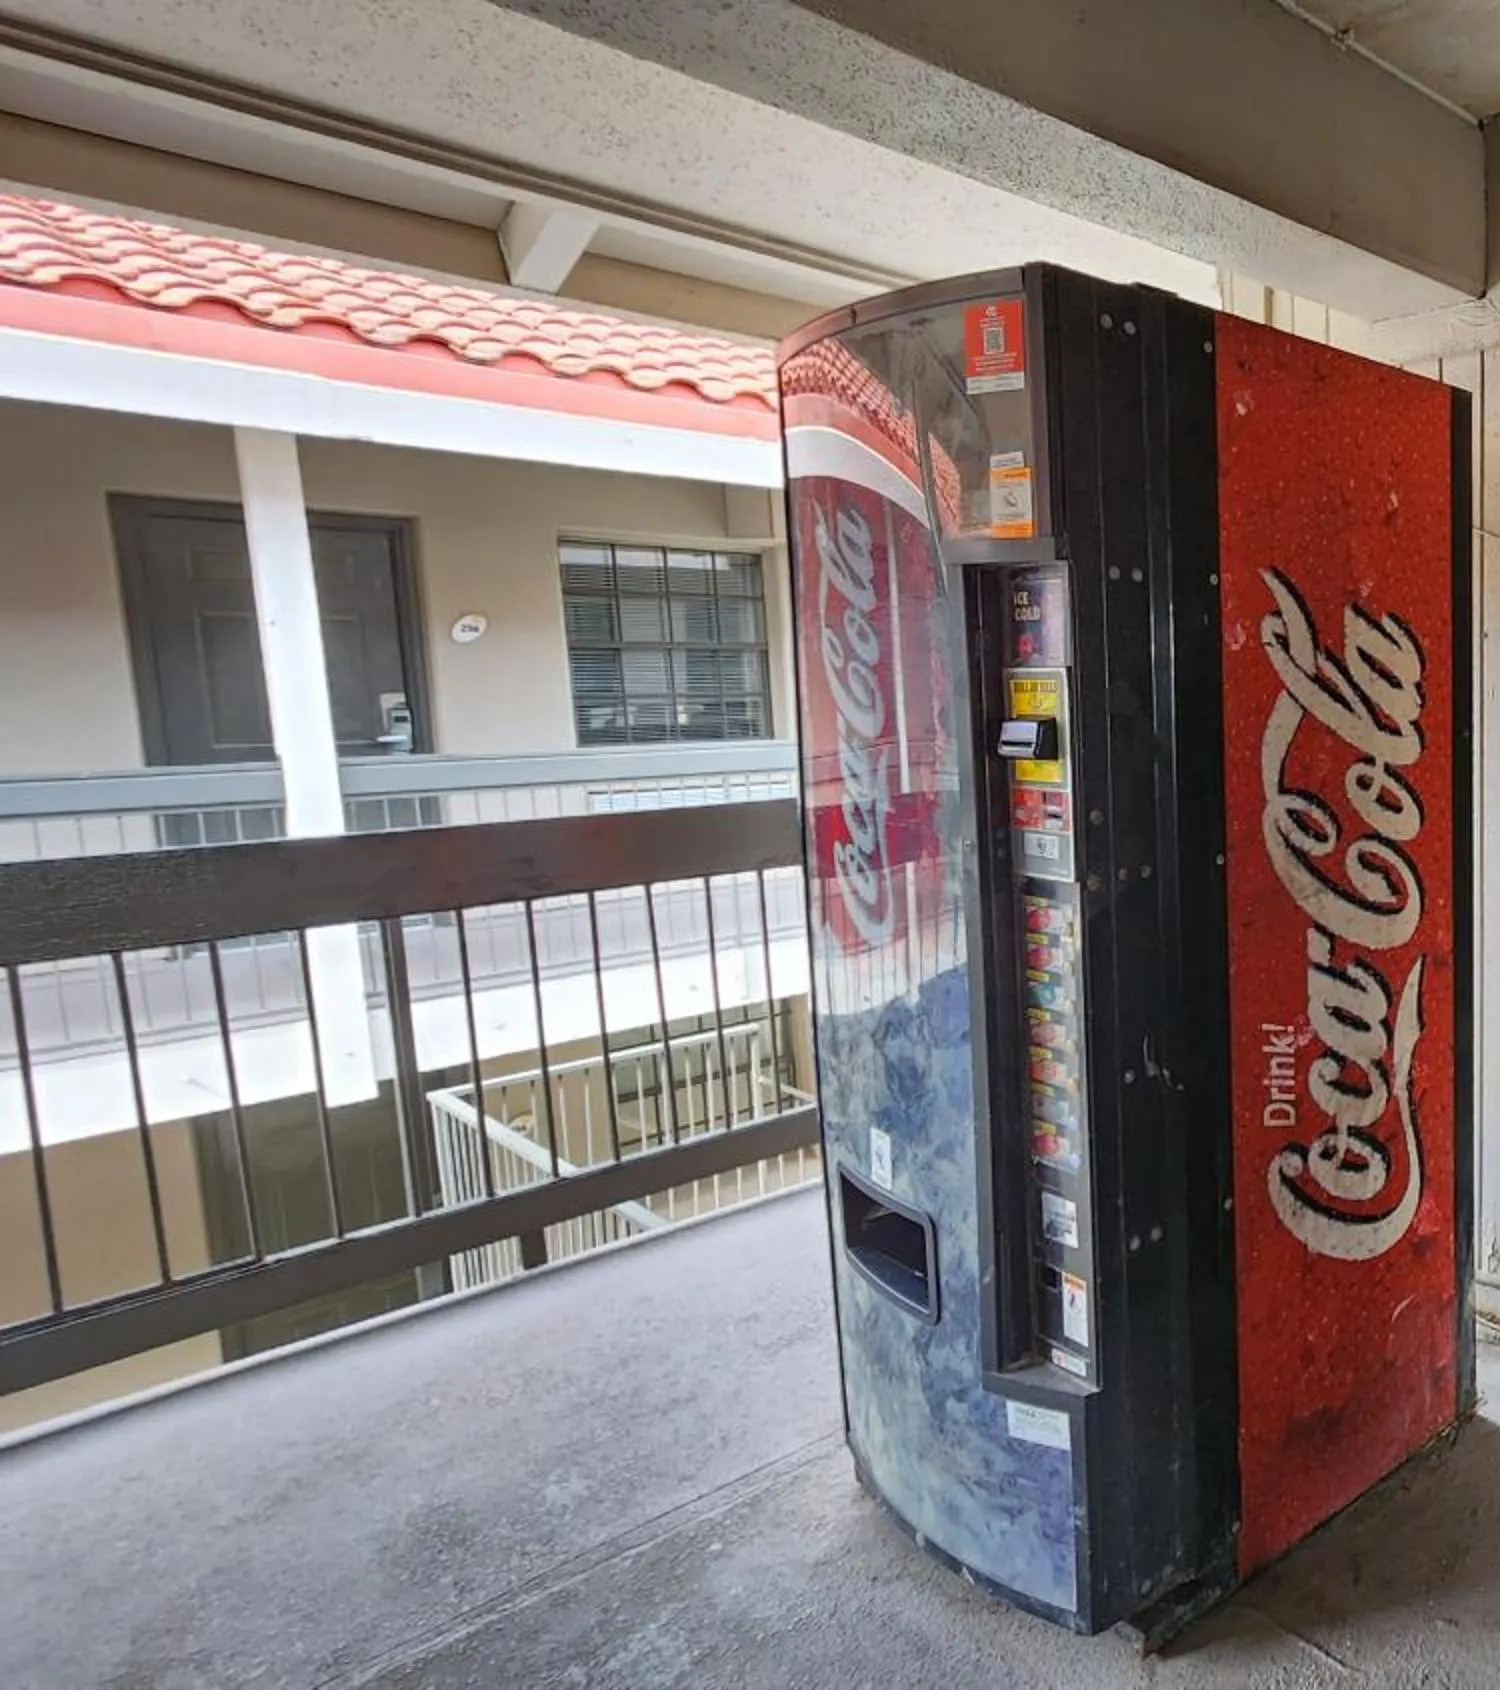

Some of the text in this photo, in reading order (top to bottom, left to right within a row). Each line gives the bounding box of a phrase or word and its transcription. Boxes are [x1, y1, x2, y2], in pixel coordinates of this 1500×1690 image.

[811, 495, 895, 952] Coca-Cola
[1261, 566, 1428, 1262] Coca-Cola
[1263, 1023, 1296, 1129] Drink!
